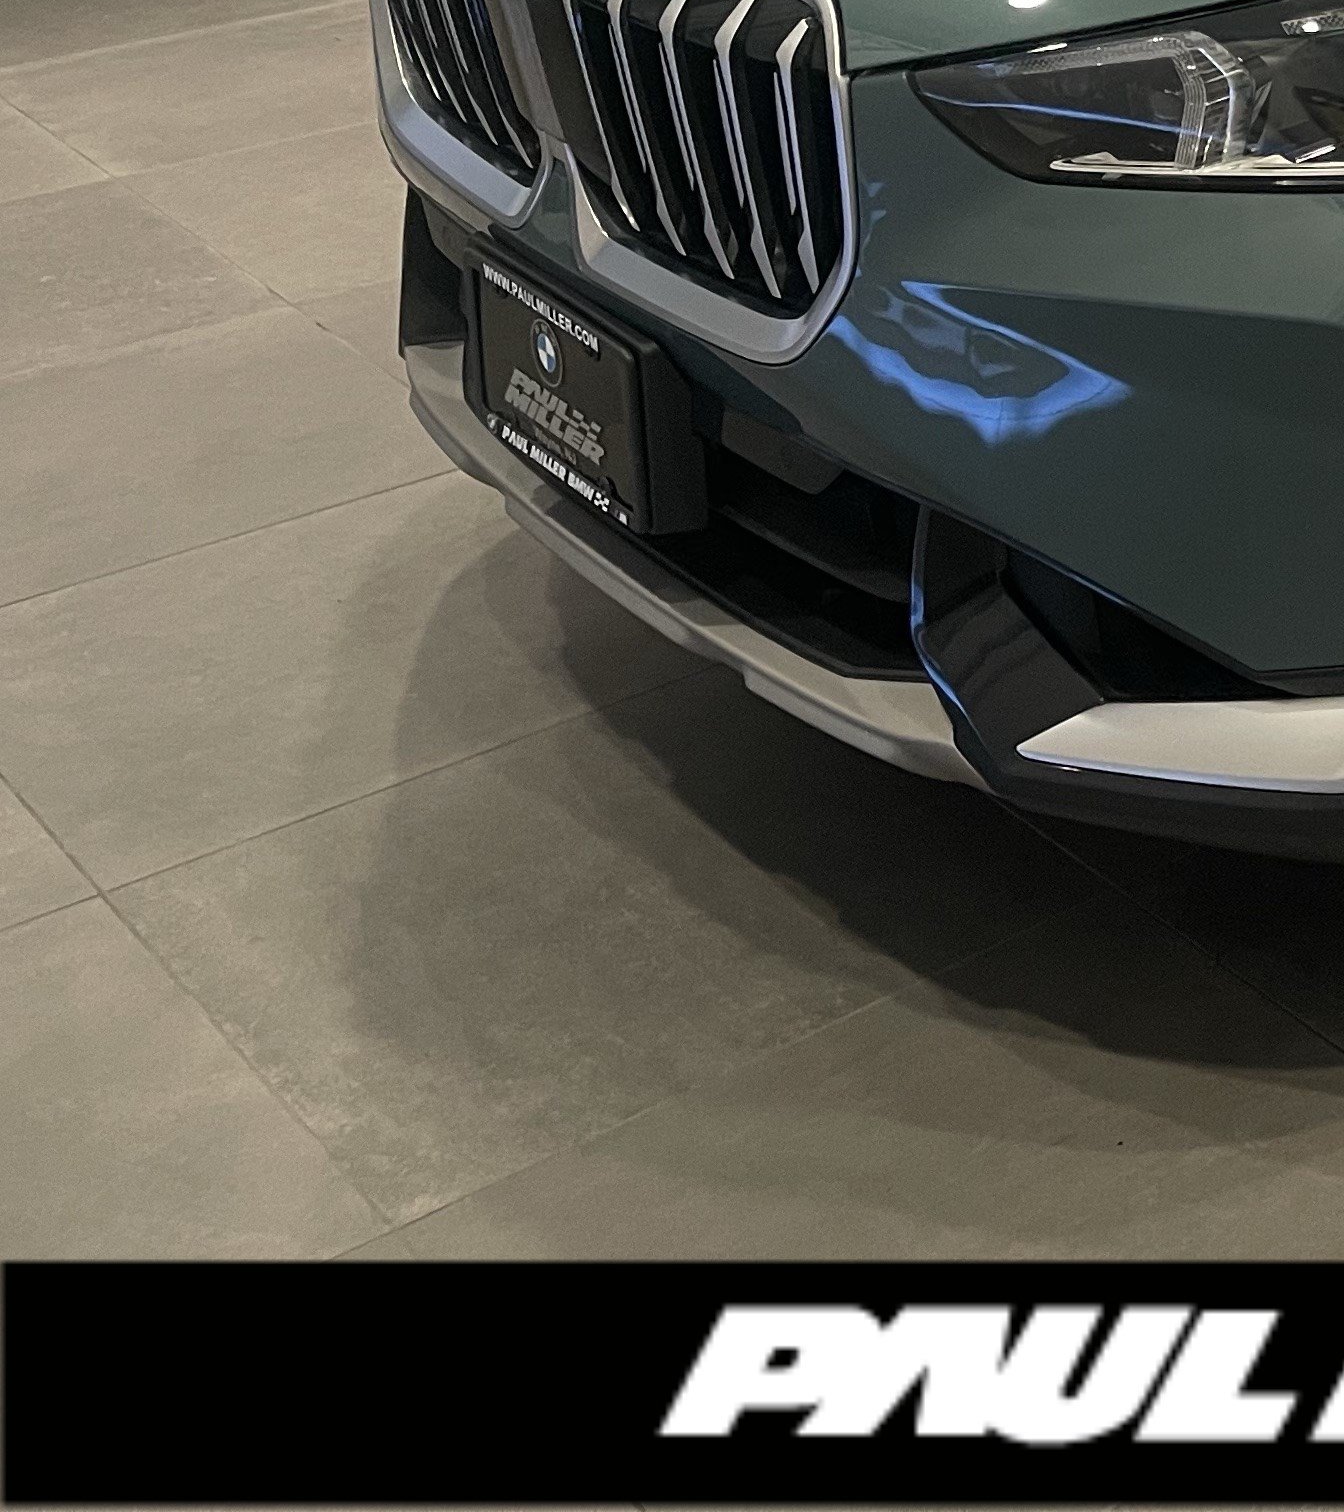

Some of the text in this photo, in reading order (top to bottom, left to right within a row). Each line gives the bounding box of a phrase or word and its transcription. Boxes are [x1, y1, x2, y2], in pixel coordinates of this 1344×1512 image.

[482, 262, 599, 353] WWW.PAULMILLER.COM
[504, 384, 605, 466] MILLER
[510, 368, 571, 423] PAUL
[501, 424, 529, 454] PAUL
[529, 444, 567, 482] MILLER
